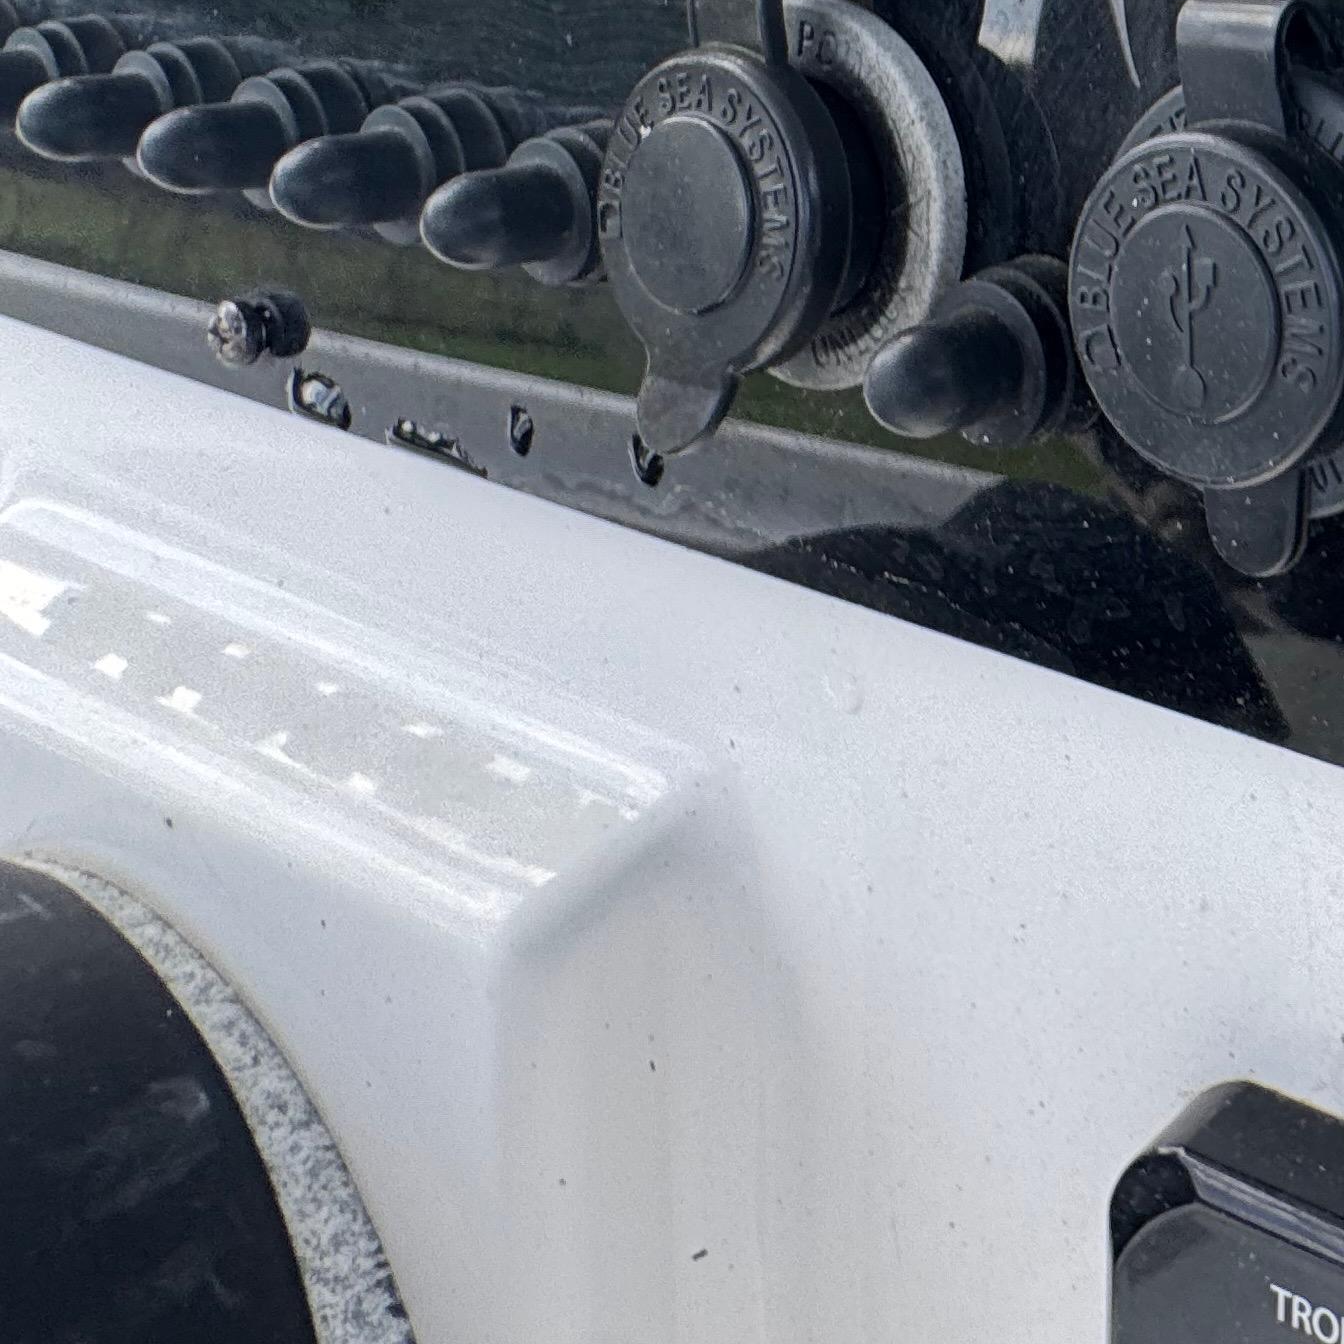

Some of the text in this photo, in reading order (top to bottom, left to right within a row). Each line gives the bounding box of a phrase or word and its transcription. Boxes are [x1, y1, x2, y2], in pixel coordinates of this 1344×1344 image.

[600, 72, 790, 282] BLUE SEA SYSTEMS
[1076, 147, 1325, 393] BLUE SEA SYSTEMS
